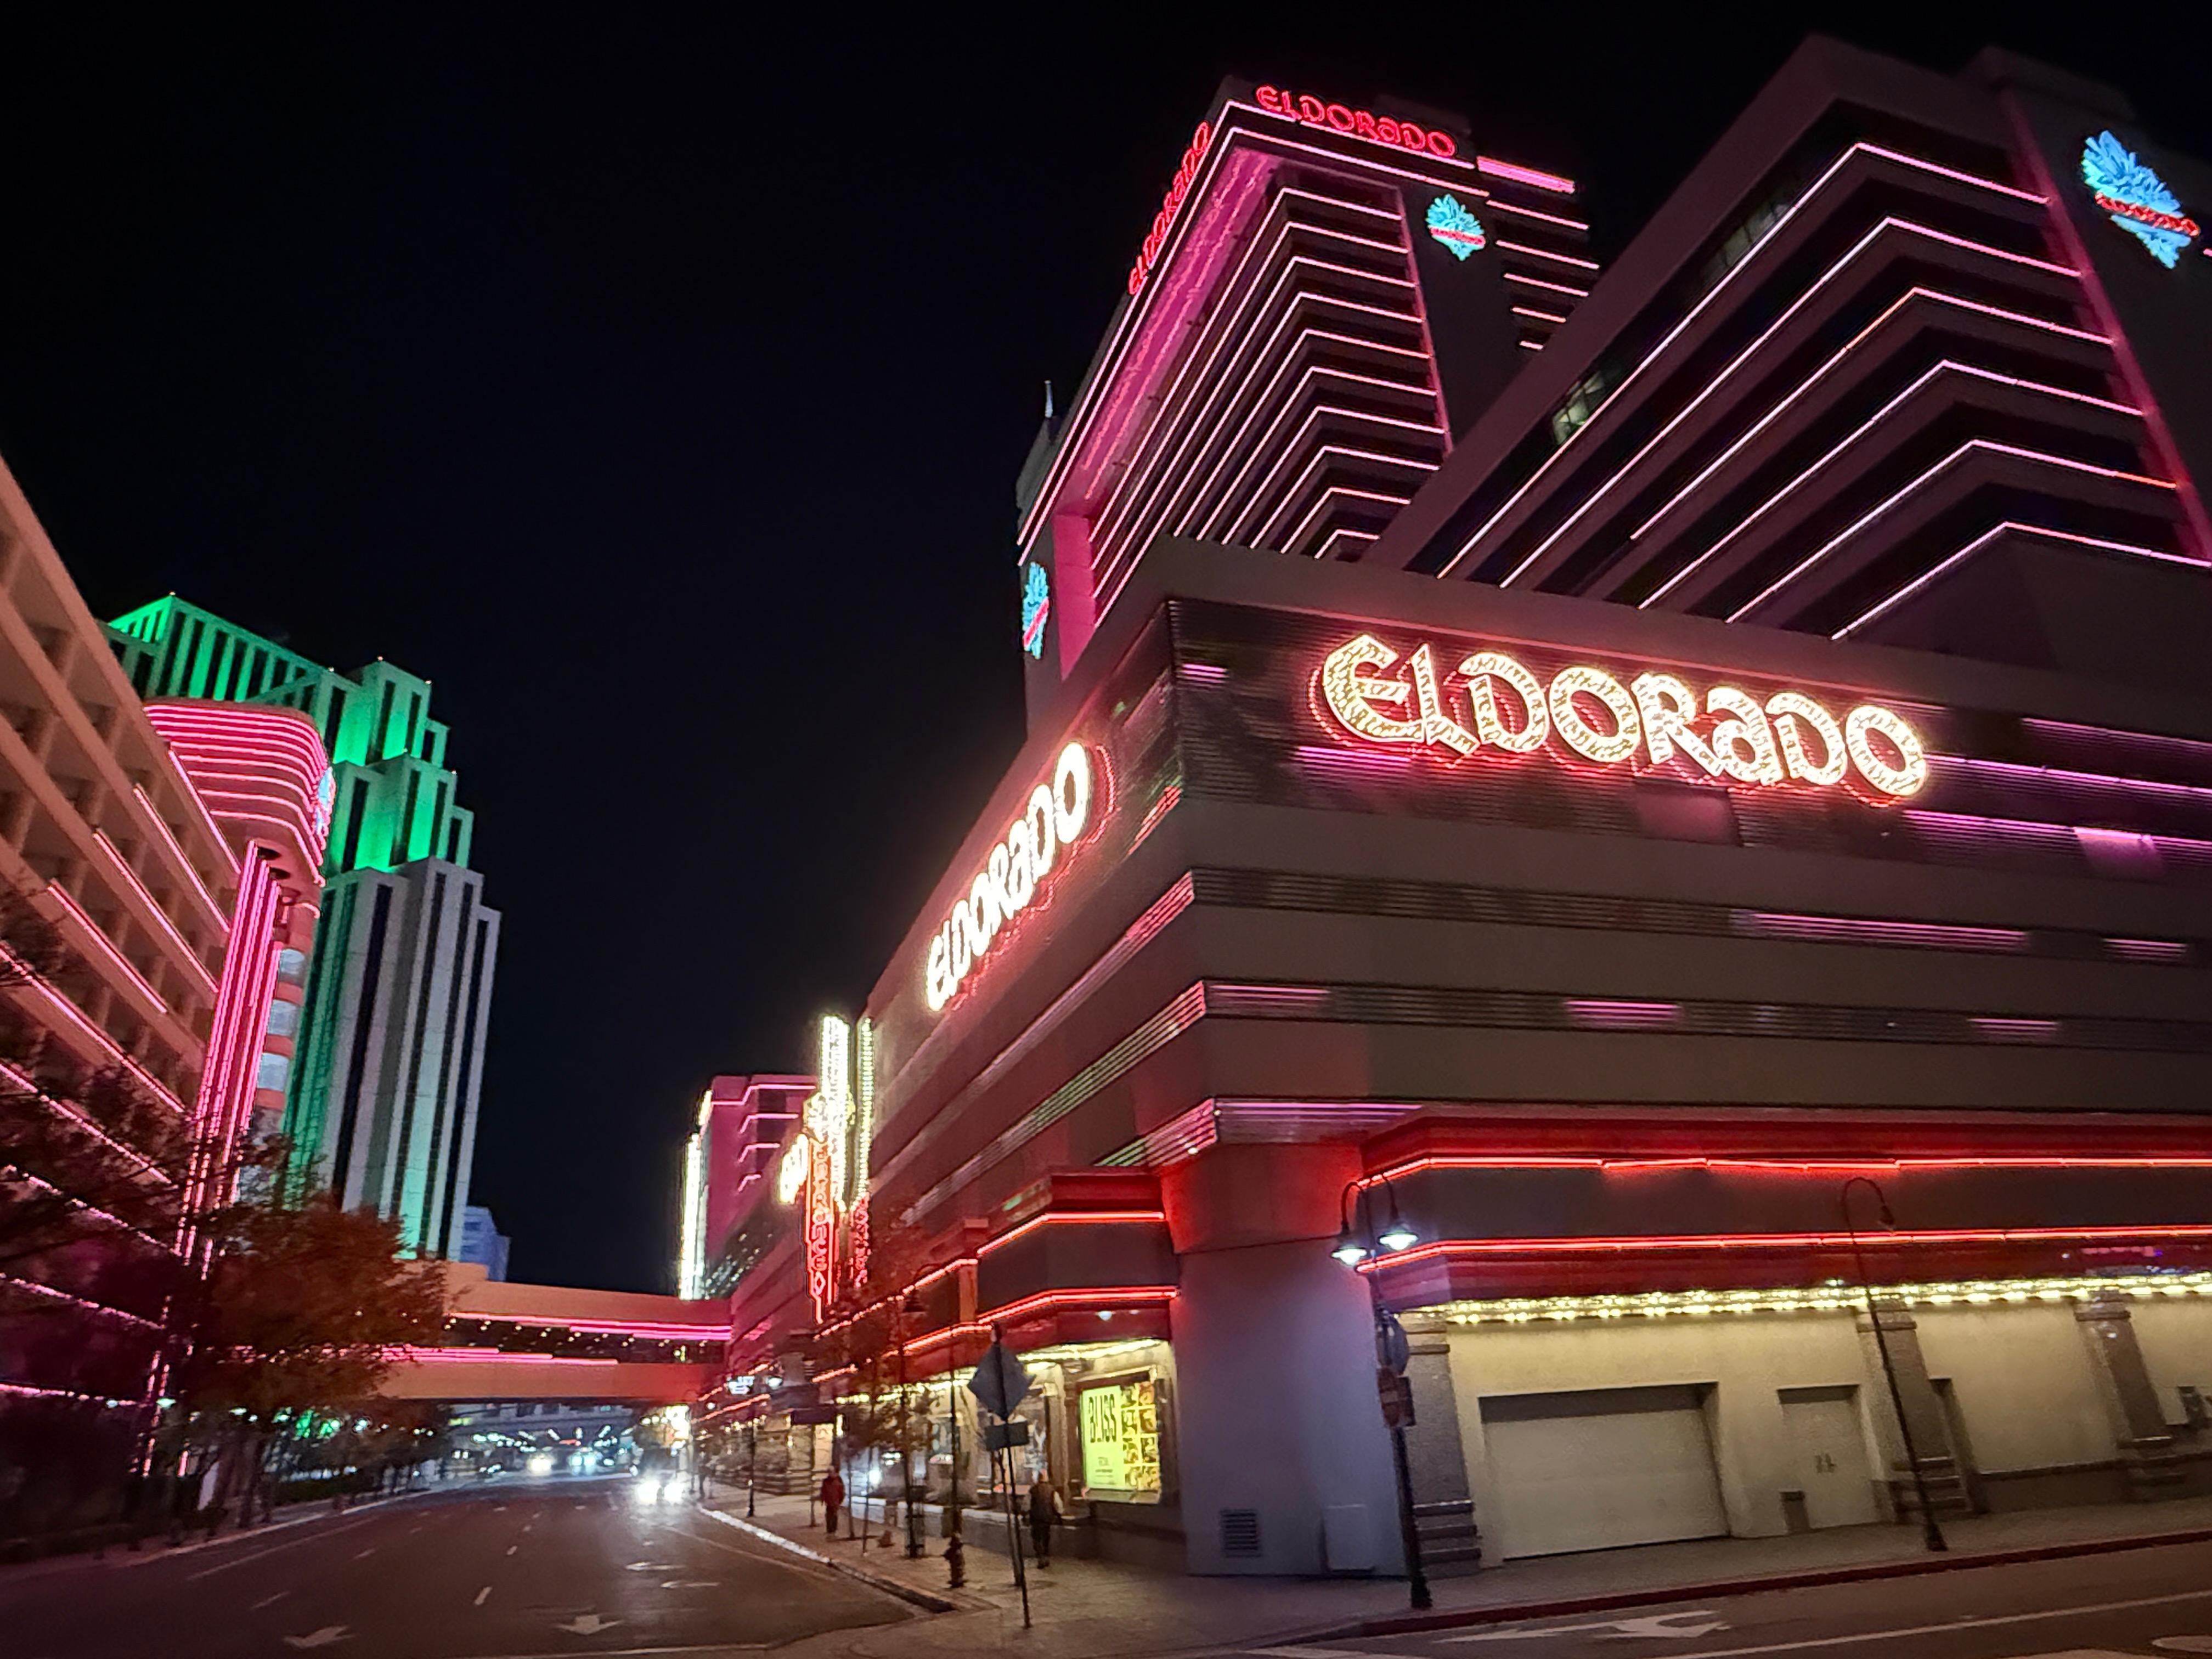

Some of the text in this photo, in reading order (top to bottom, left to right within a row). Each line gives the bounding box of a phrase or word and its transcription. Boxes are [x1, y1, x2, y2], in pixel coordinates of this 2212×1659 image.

[1255, 84, 1455, 157] ELDORADO
[1322, 634, 1928, 797] ELDORADO
[927, 742, 1091, 1012] ELDORADO
[1089, 1394, 1117, 1443] BLISS
